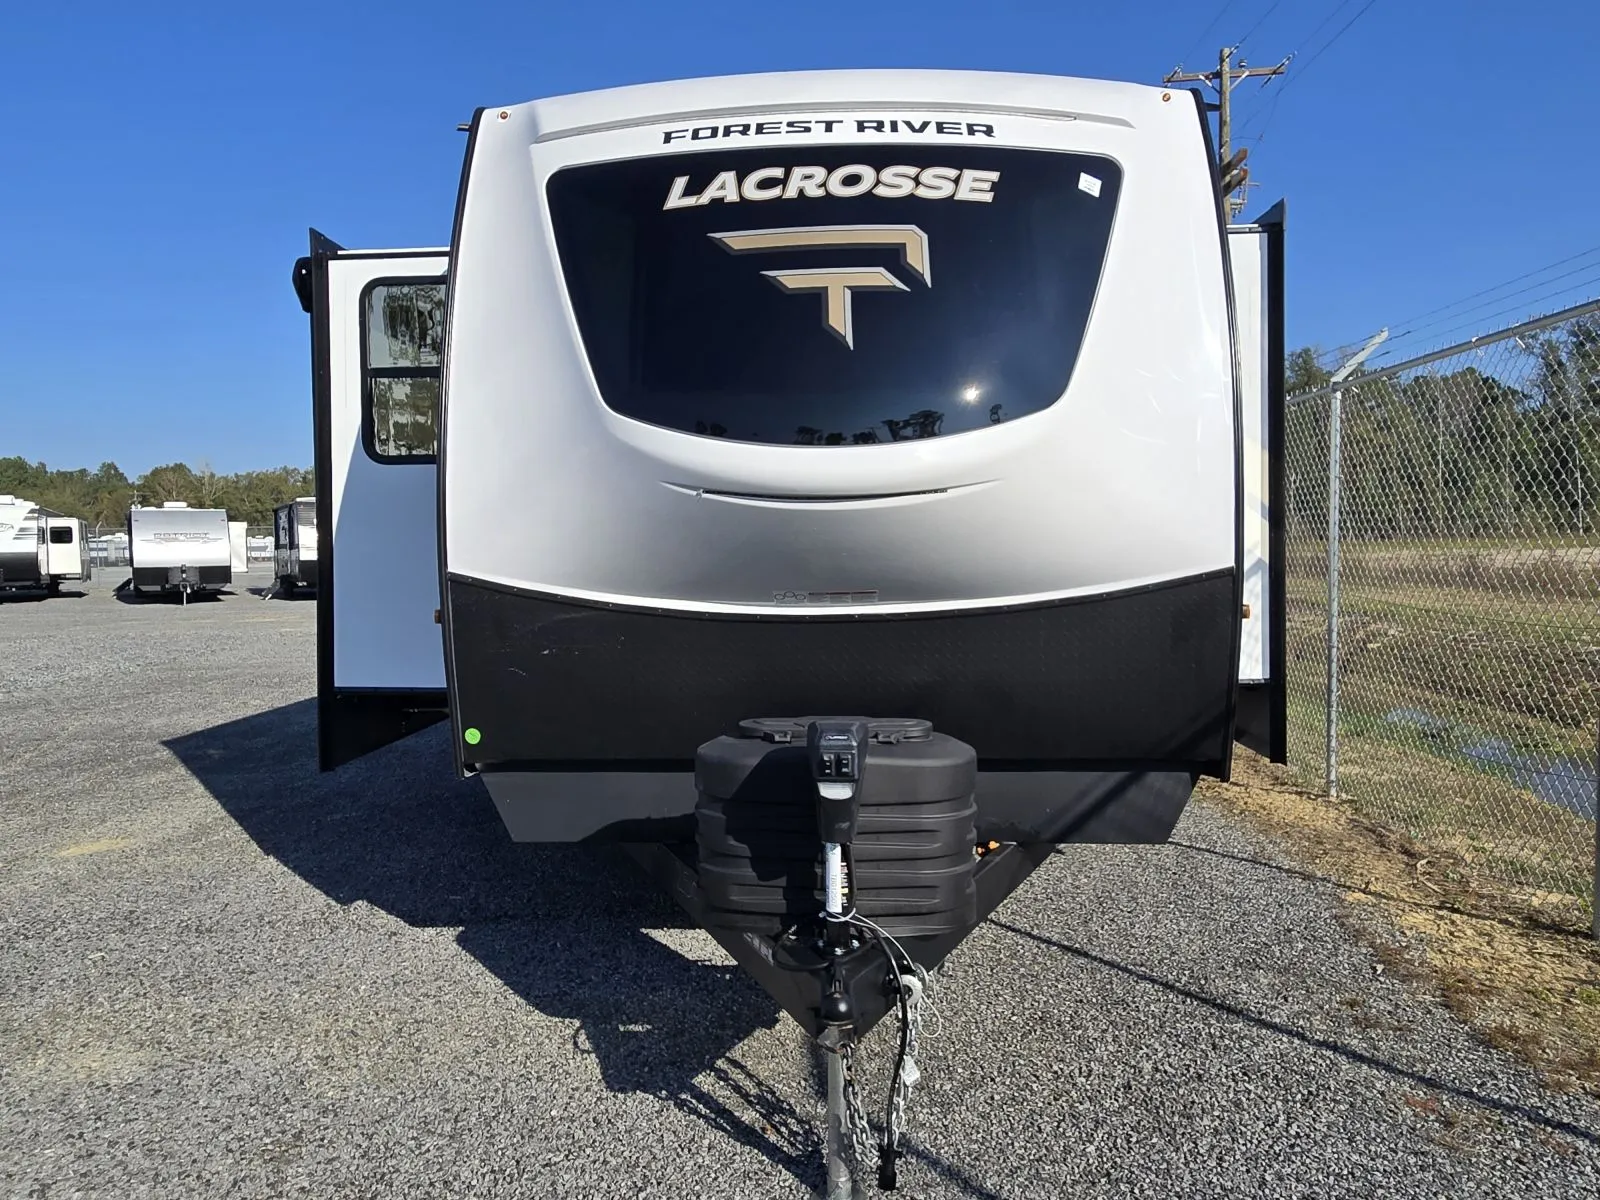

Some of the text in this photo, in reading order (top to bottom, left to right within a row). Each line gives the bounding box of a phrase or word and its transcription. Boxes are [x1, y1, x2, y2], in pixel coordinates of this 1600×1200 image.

[663, 120, 997, 144] FOREST RIVER
[663, 164, 1000, 210] LACROSSE
